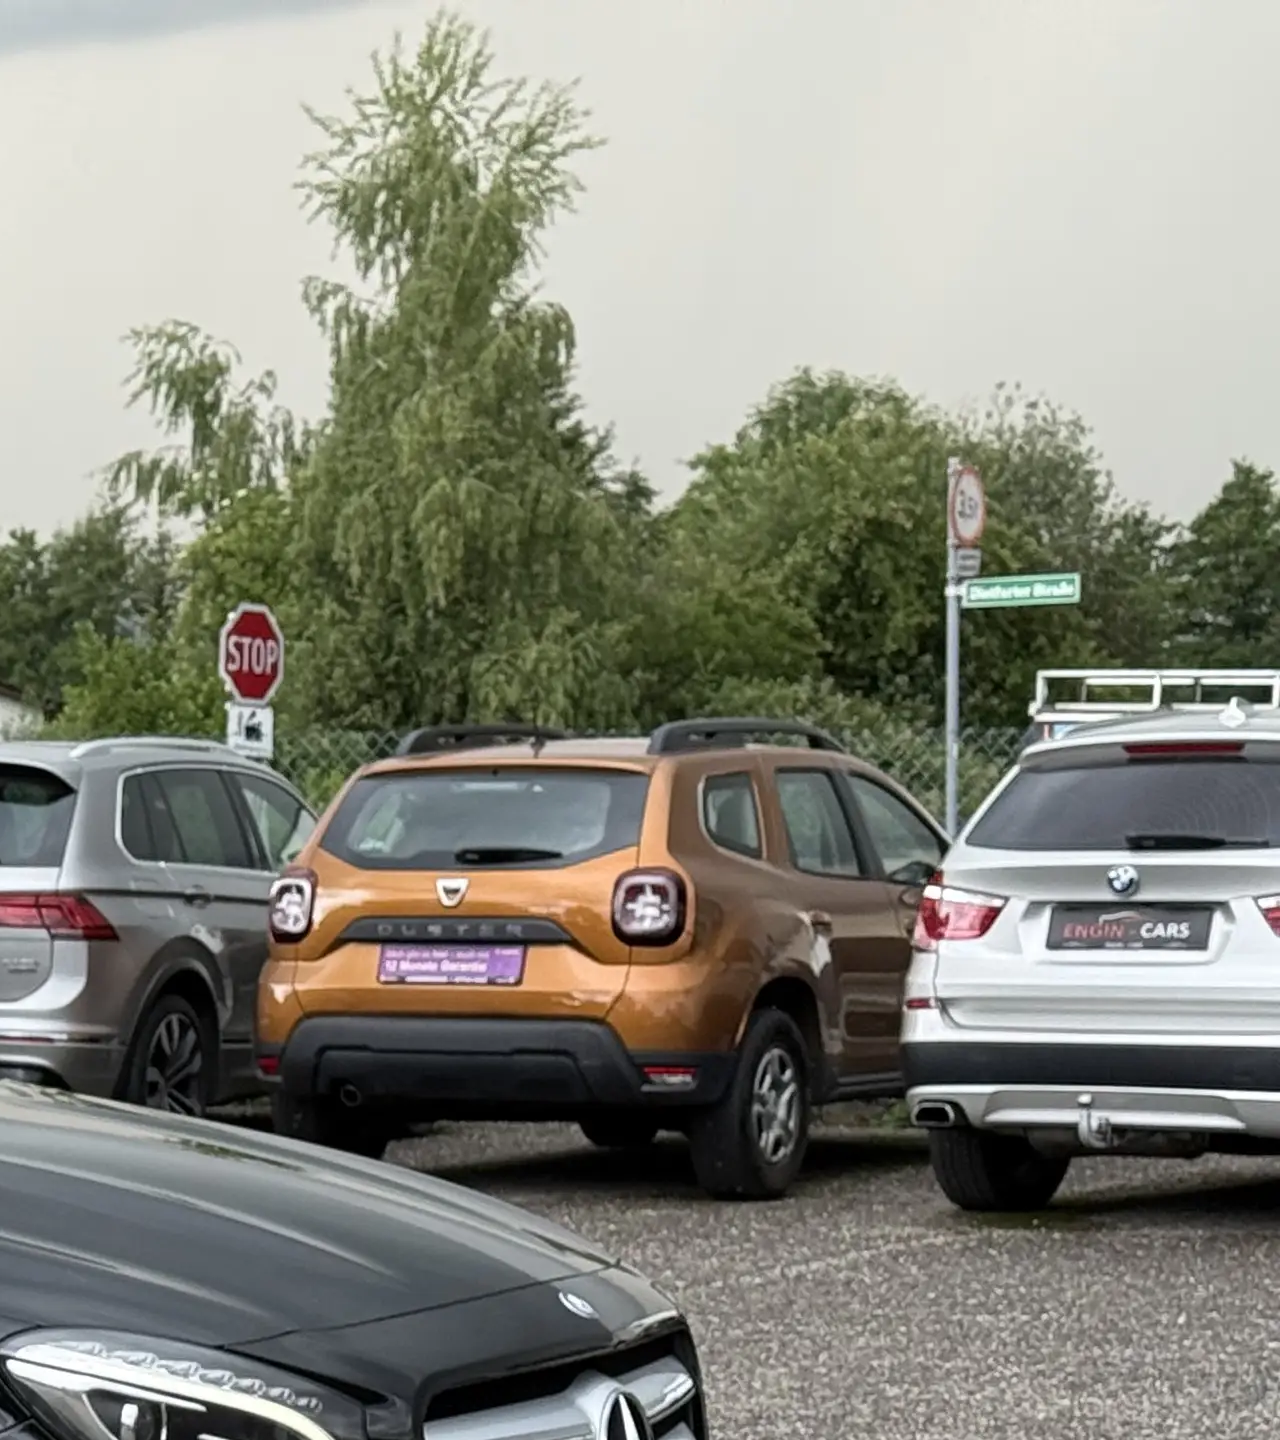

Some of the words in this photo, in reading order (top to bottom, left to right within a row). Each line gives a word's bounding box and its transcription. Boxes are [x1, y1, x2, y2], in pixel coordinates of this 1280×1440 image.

[227, 635, 279, 675] STOP
[1062, 922, 1125, 939] ENGIN
[1140, 922, 1190, 938] CARS
